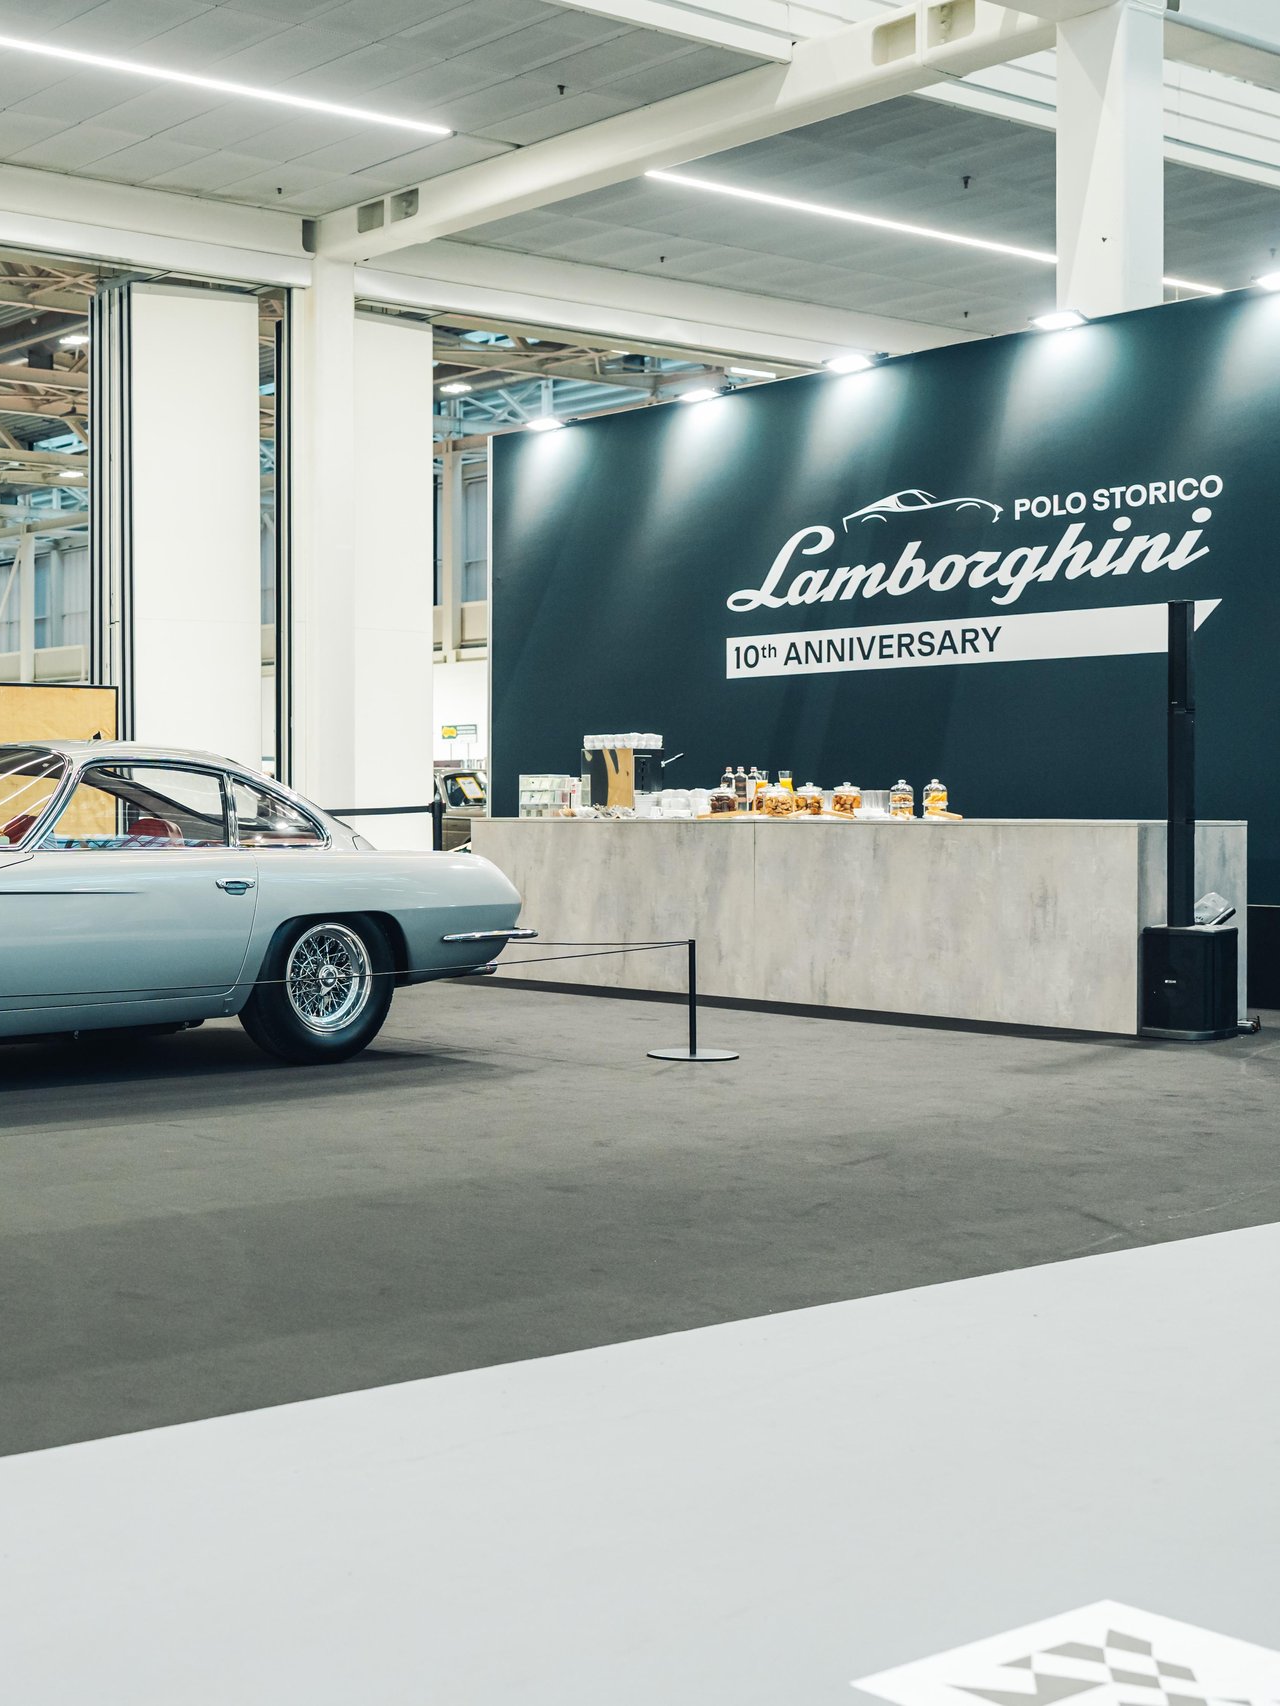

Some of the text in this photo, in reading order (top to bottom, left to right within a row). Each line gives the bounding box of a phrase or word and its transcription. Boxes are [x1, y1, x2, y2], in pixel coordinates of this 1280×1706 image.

[1013, 474, 1224, 521] POLO STORICO
[725, 506, 1211, 613] Lamborghini
[732, 626, 1002, 671] 10th ANNIVERSARY
